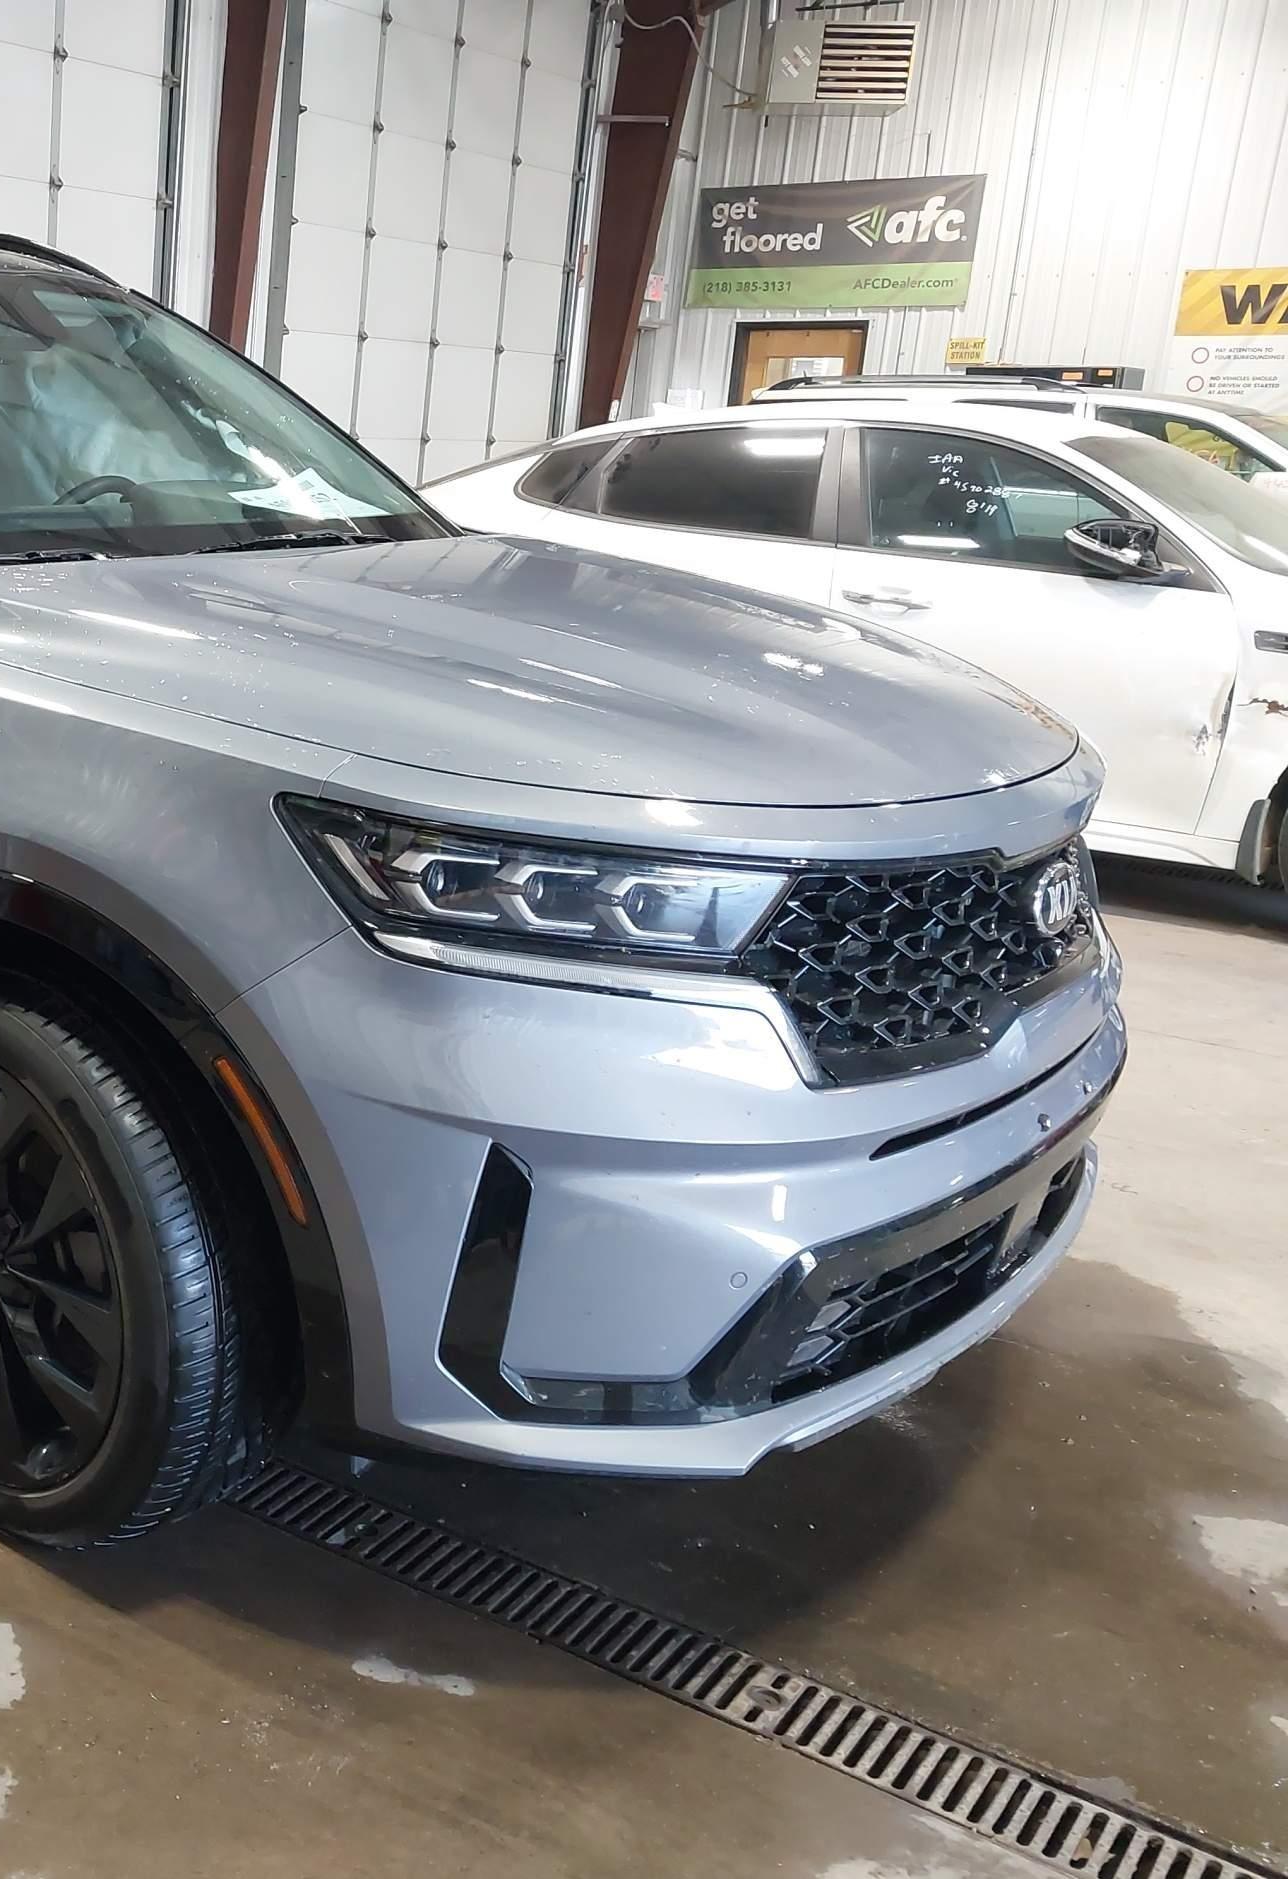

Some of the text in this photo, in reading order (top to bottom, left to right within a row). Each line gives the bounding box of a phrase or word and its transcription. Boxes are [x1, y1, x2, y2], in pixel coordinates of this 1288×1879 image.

[712, 197, 759, 227] get
[722, 223, 823, 254] floored
[702, 280, 791, 294] (218) 385-3131
[1220, 283, 1288, 324] W
[950, 341, 984, 350] SPILL-KIT
[950, 351, 981, 360] STATION
